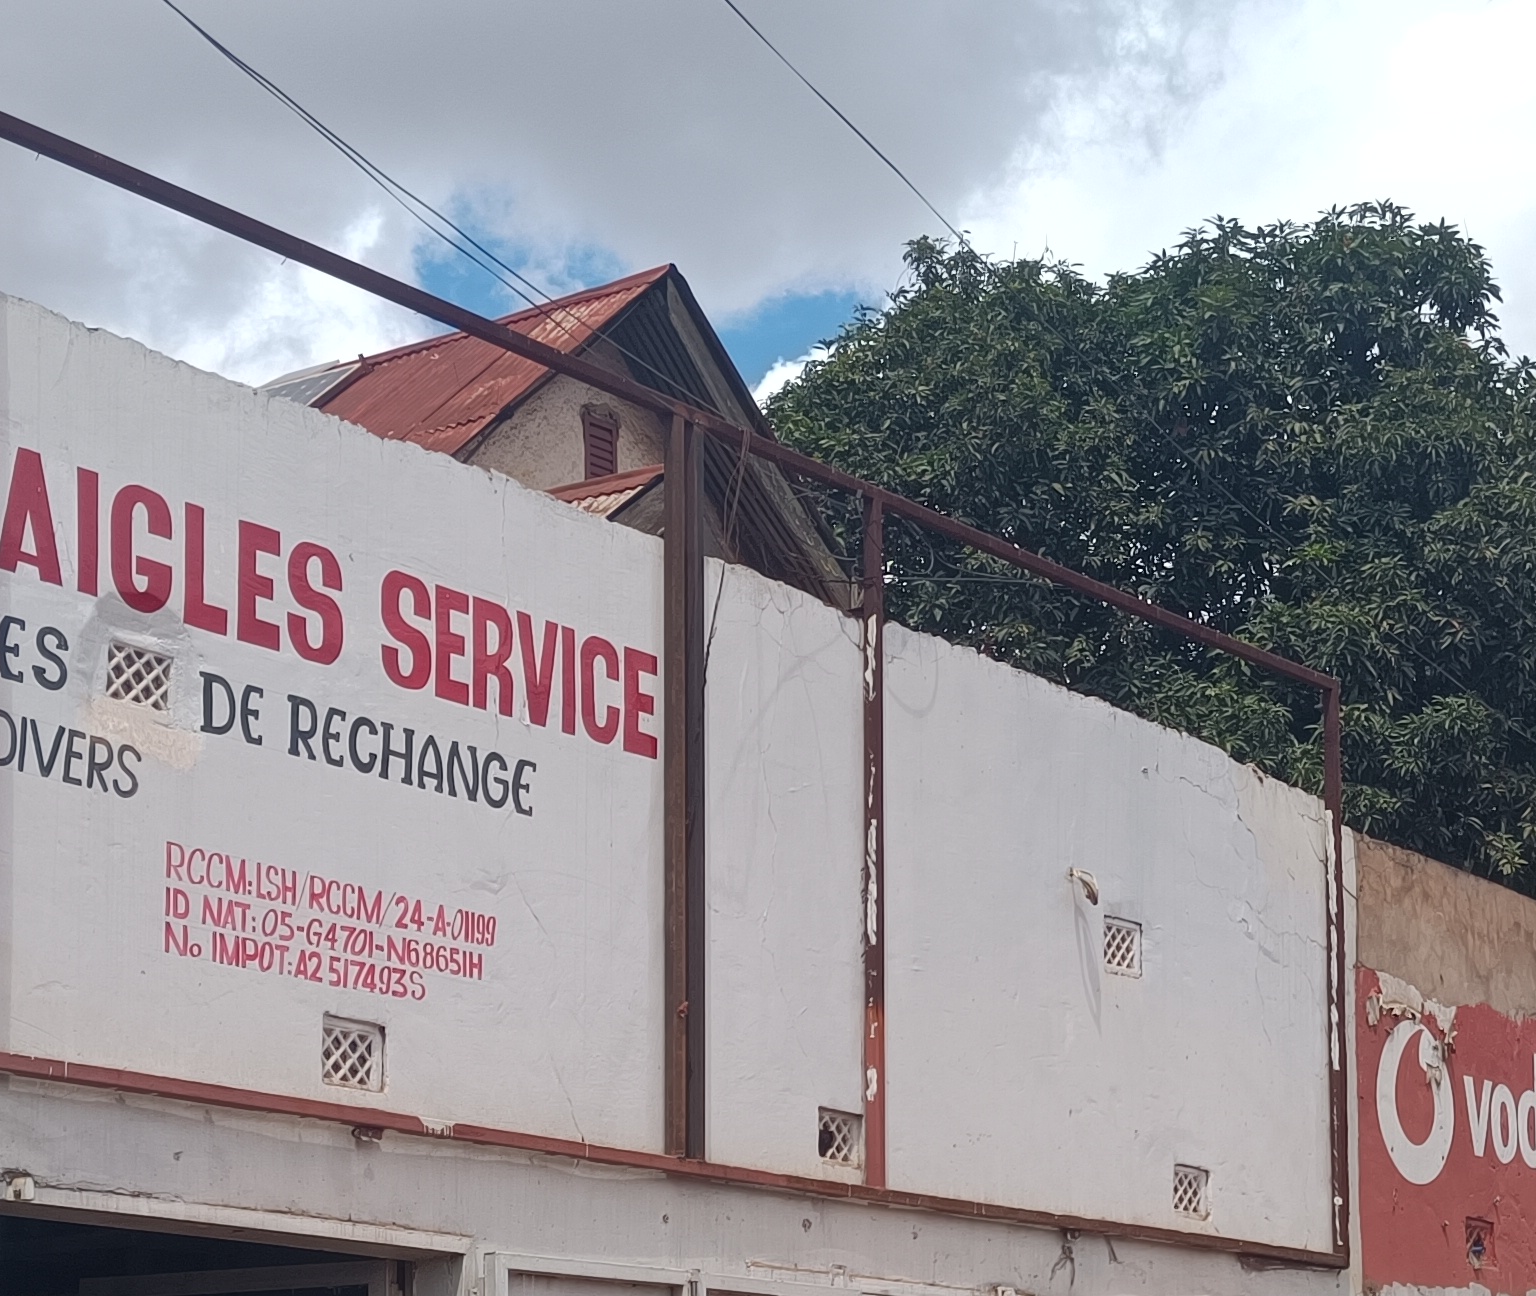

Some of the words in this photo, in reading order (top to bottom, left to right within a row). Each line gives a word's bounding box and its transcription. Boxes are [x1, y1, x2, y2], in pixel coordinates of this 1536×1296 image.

[381, 569, 659, 760] SERVICE
[199, 671, 264, 747] DE
[286, 693, 538, 818] RECHANGE
[165, 886, 190, 920] ID
[201, 894, 257, 933] NAT:
